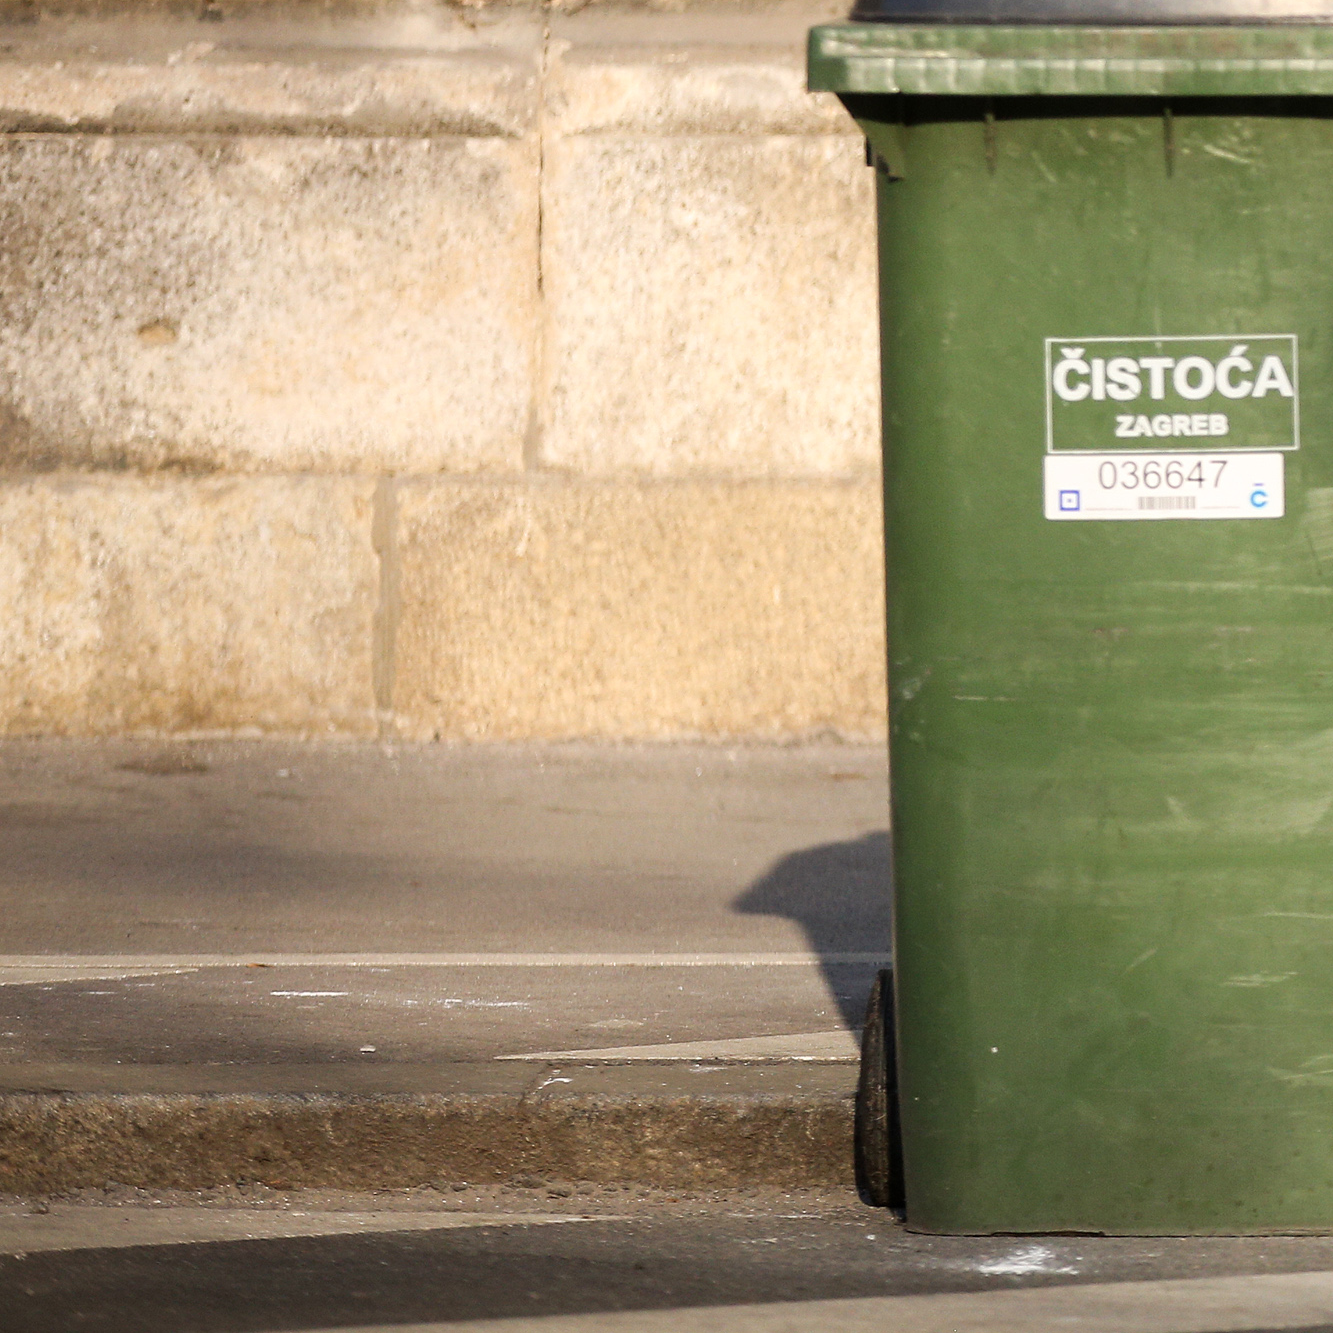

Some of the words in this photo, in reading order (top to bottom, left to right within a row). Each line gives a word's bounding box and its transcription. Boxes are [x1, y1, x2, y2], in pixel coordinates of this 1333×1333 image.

[1052, 344, 1294, 402] ČISTOĆA
[1115, 413, 1230, 438] ZAGREB
[1098, 460, 1229, 490] 036647
